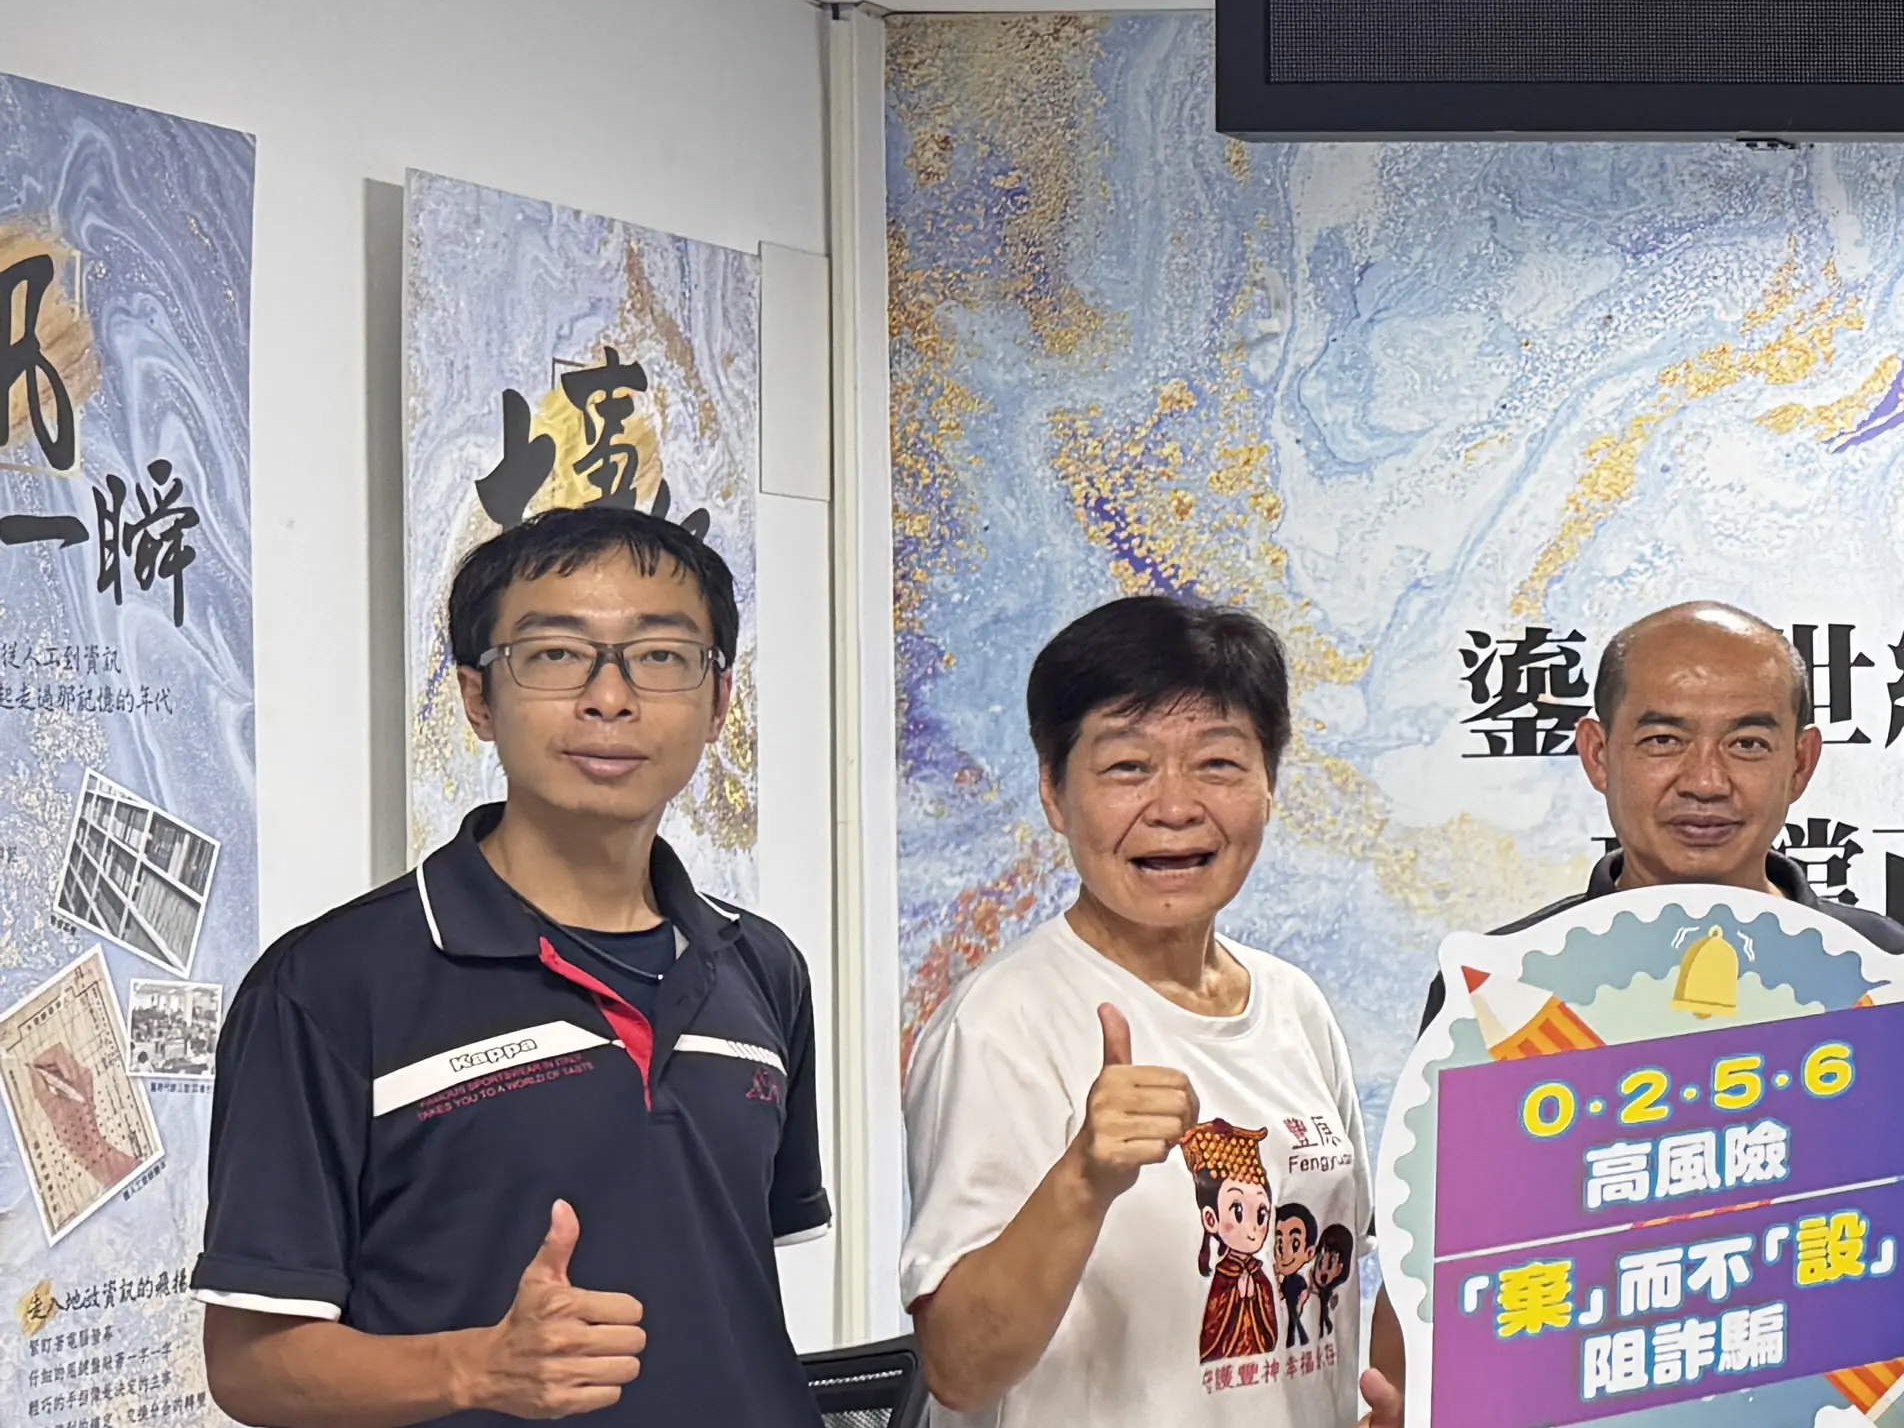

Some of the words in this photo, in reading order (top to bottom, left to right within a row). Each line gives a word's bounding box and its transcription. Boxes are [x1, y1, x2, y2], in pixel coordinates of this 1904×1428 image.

[449, 1038, 538, 1072] Kappa
[420, 1085, 466, 1108] FAMOUS
[454, 1093, 478, 1108] YOU
[480, 1087, 497, 1099] TO
[498, 1085, 506, 1093] A
[507, 1073, 546, 1091] WORLD
[547, 1069, 560, 1081] OF
[1584, 1121, 1788, 1210] 高風險
[1462, 1212, 1895, 1337] 「棄」而不「設」
[1582, 1304, 1786, 1400] 阻詐騙
